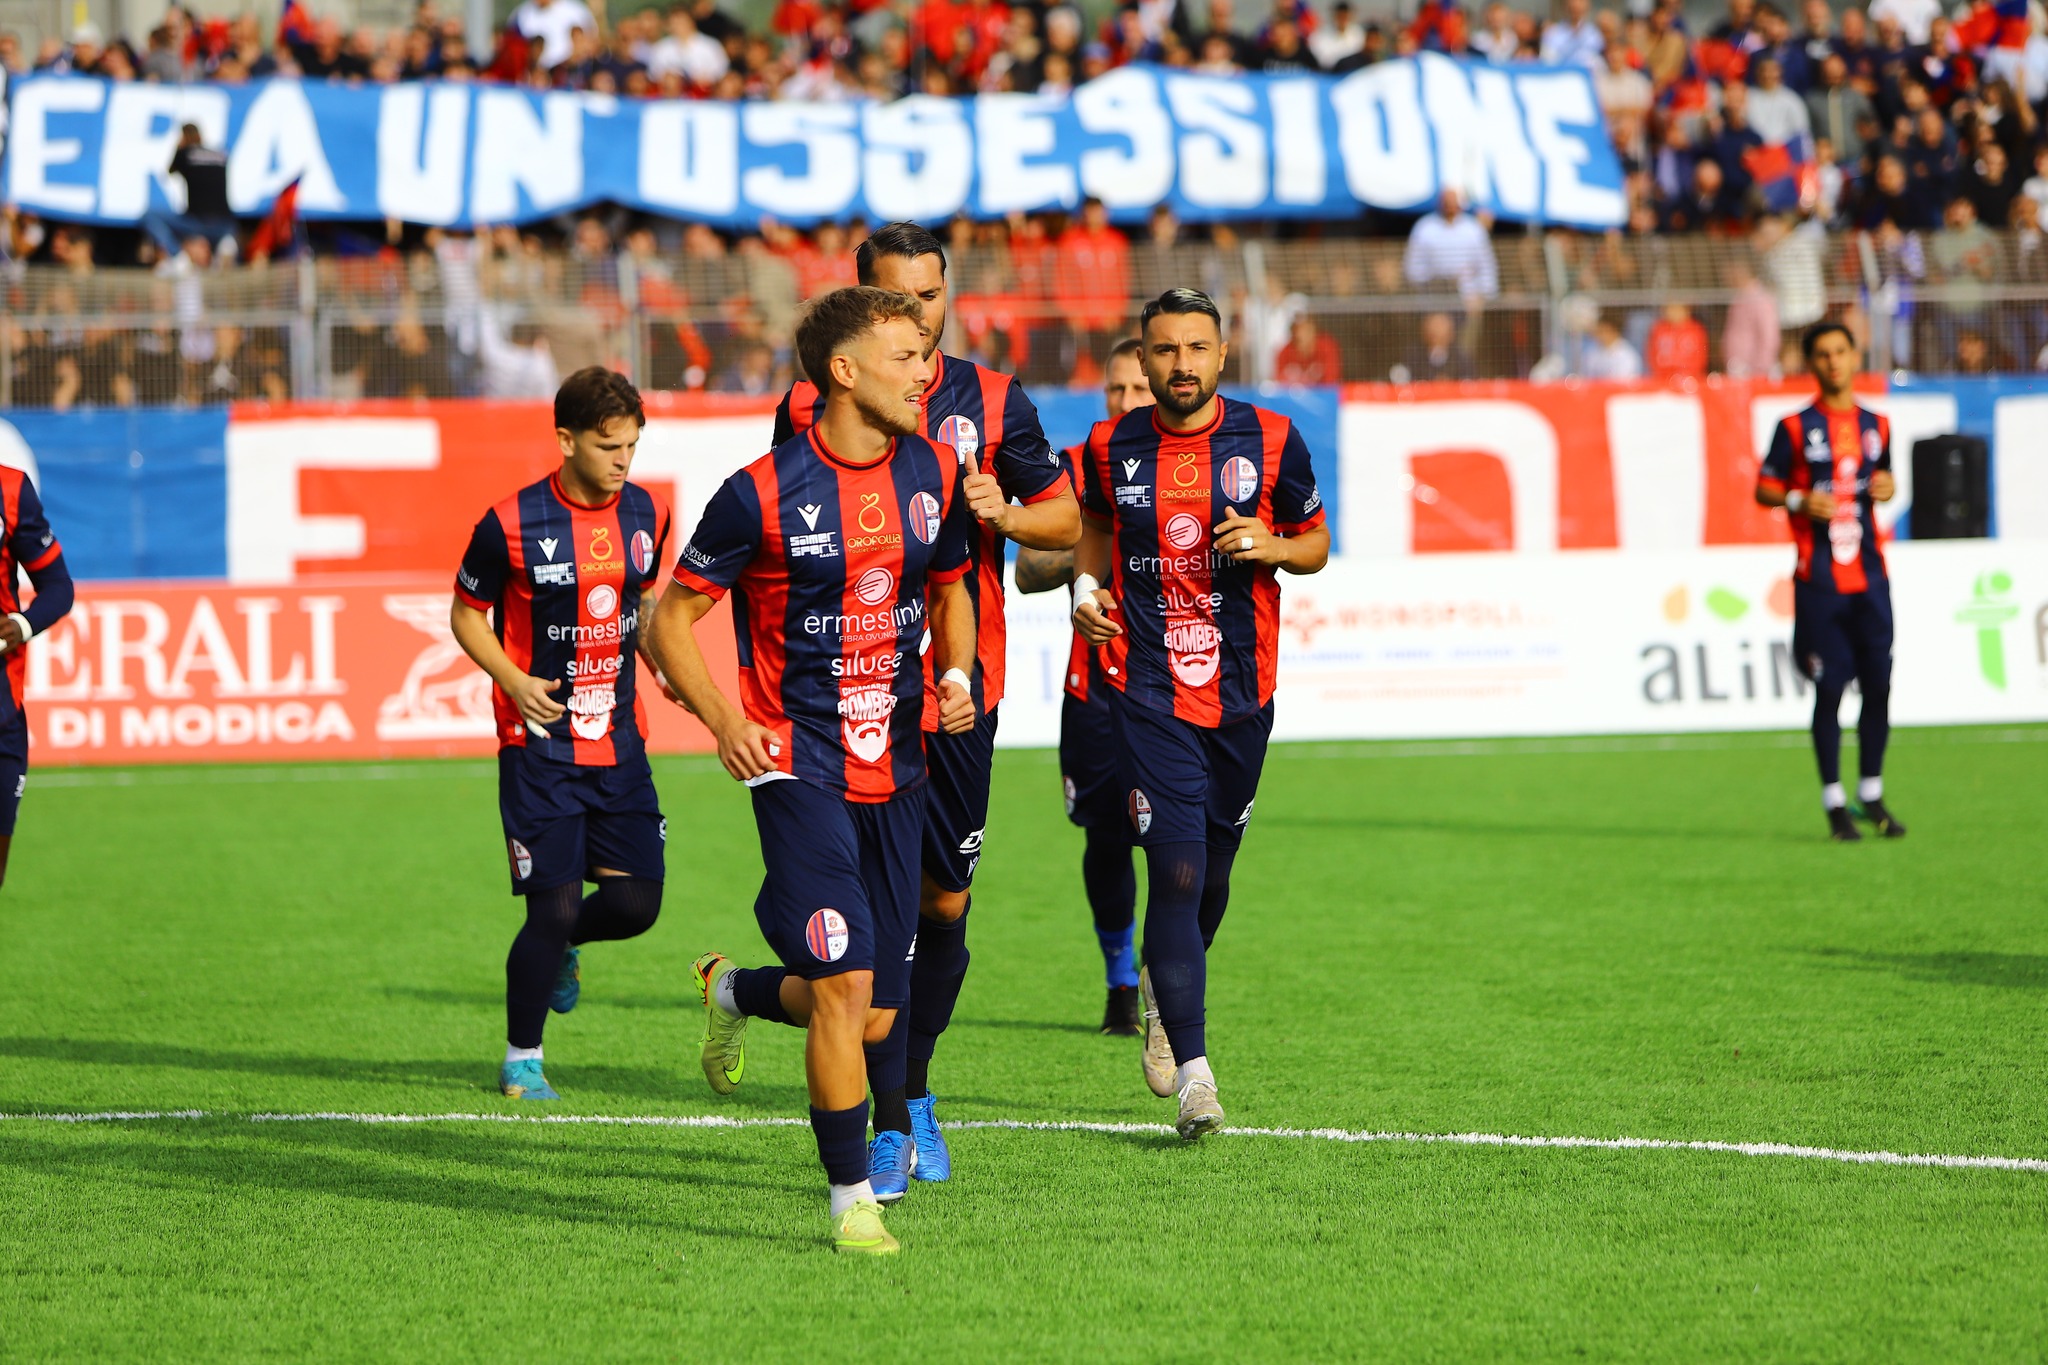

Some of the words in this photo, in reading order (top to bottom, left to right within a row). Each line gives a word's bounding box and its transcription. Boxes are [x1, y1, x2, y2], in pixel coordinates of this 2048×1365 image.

[8, 76, 348, 222] ERA
[803, 598, 924, 634] ermeslink
[24, 596, 348, 701] ERALI
[838, 634, 864, 643] FIBRA
[865, 628, 904, 642] OVUNQUE
[1163, 624, 1223, 653] BOMBER
[841, 683, 891, 697] CHIAMARSI
[47, 706, 106, 749] DI
[120, 701, 355, 748] MODICA
